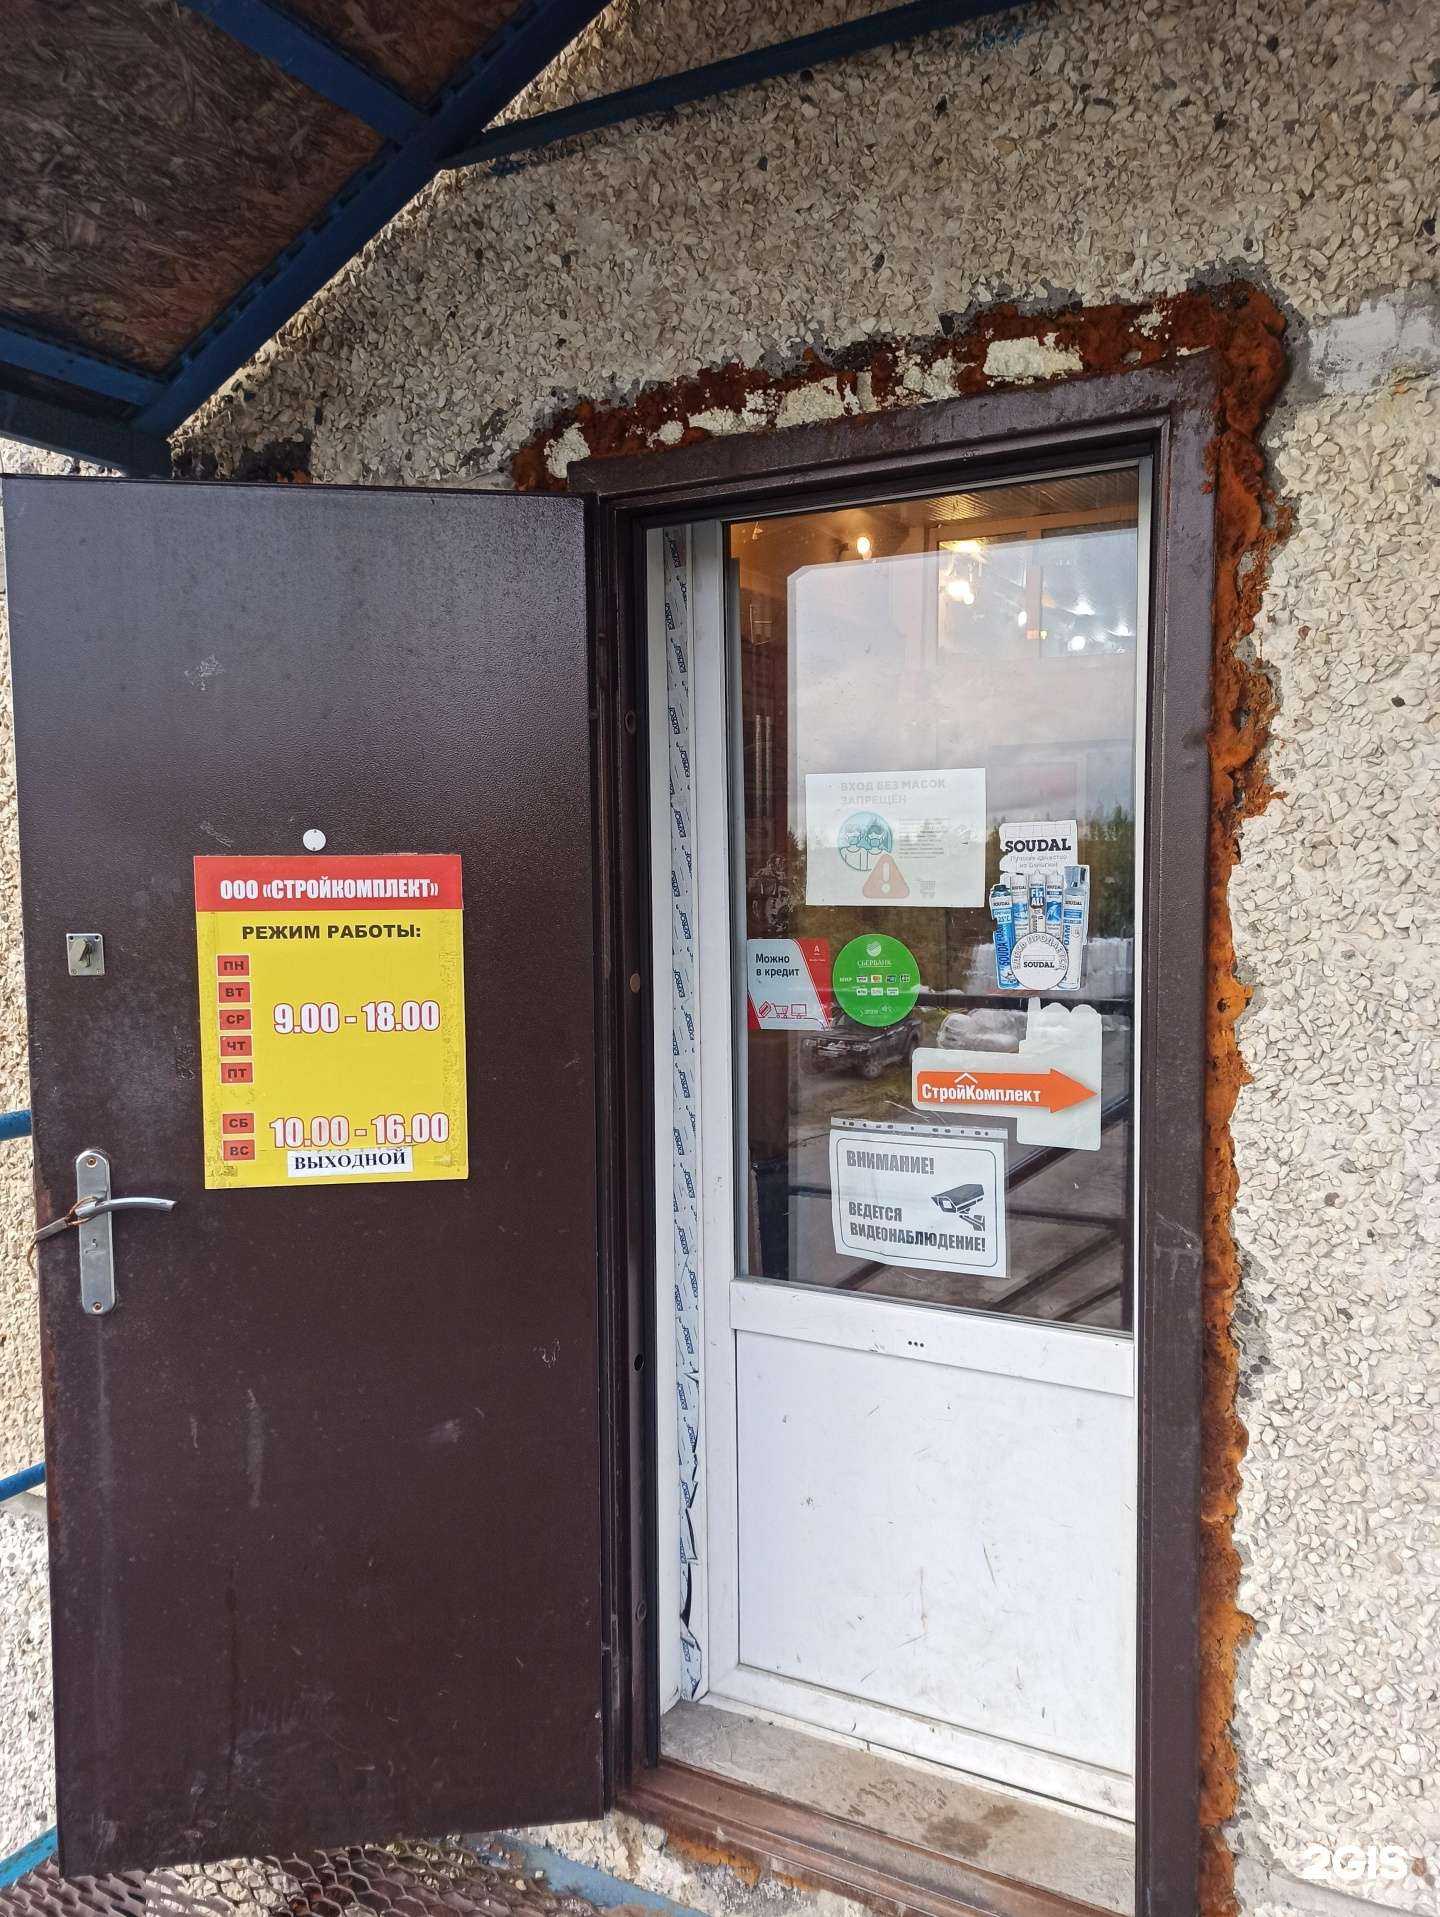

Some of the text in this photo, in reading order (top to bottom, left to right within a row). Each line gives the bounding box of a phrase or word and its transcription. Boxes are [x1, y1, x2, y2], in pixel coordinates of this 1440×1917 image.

[840, 779, 946, 792] ВХОД БЕЗ МАСОК
[1005, 838, 1071, 853] SOUDAL
[220, 876, 439, 899] ООО «СТРОЙКОМПЛЕКТ»
[242, 924, 421, 940] РЕЖИМ РАБОТЫ:
[223, 961, 244, 971] ПН
[755, 953, 790, 964] Можно
[765, 968, 800, 978] кредит
[225, 987, 244, 998] ВТ
[226, 1014, 245, 1024] СР
[273, 1001, 340, 1034] 9.00
[361, 1000, 440, 1032] 18.00
[227, 1041, 246, 1051] ЧТ
[228, 1068, 247, 1078] ПТ
[921, 1083, 1041, 1103] СтройКомплект
[229, 1119, 248, 1128] СБ
[269, 1115, 350, 1148] 10.00
[371, 1112, 450, 1144] 16.00
[229, 1146, 249, 1156] ВС
[294, 1149, 406, 1170] ВЫХОДНОЙ
[846, 1150, 935, 1175] ВНИМАНИЕ!
[848, 1201, 902, 1222] ВЕДЕТСЯ
[850, 1222, 986, 1252] ВИДЕОНАБЛЮДЕНИЕ!
